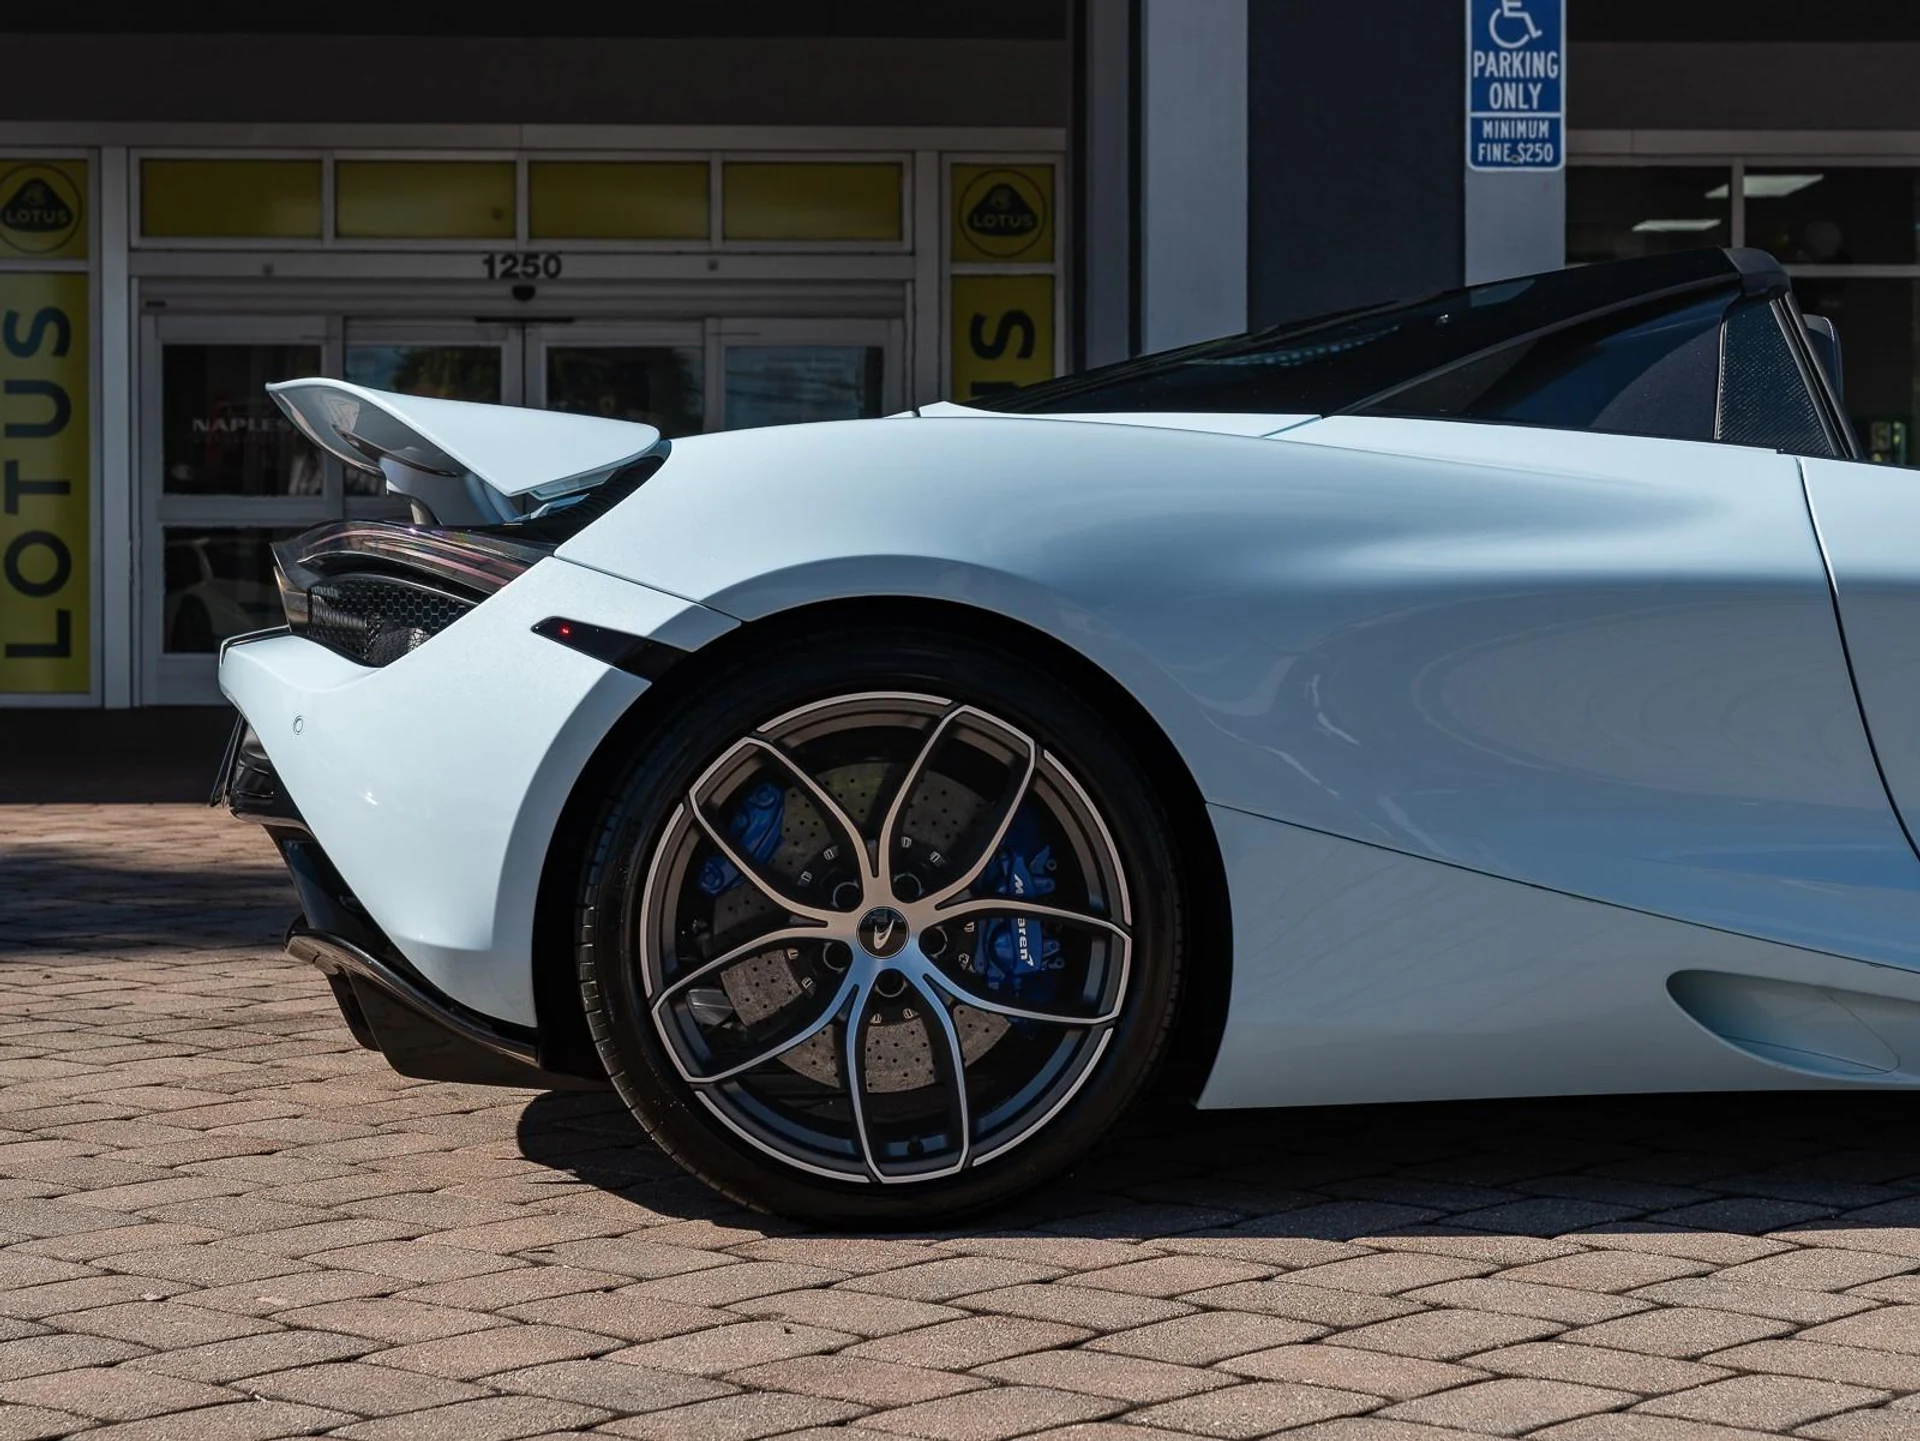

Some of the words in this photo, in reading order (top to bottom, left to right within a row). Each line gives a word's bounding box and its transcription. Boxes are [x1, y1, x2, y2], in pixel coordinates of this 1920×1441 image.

[1473, 51, 1559, 78] PARKING
[1489, 82, 1542, 110] ONLY
[1482, 120, 1549, 139] MINIMUM
[1478, 143, 1511, 162] FINE
[1517, 142, 1554, 164] $250
[5, 209, 69, 224] LOTUS
[972, 213, 1034, 228] LOTUS
[482, 253, 562, 280] 1250
[4, 305, 72, 659] LOTUS
